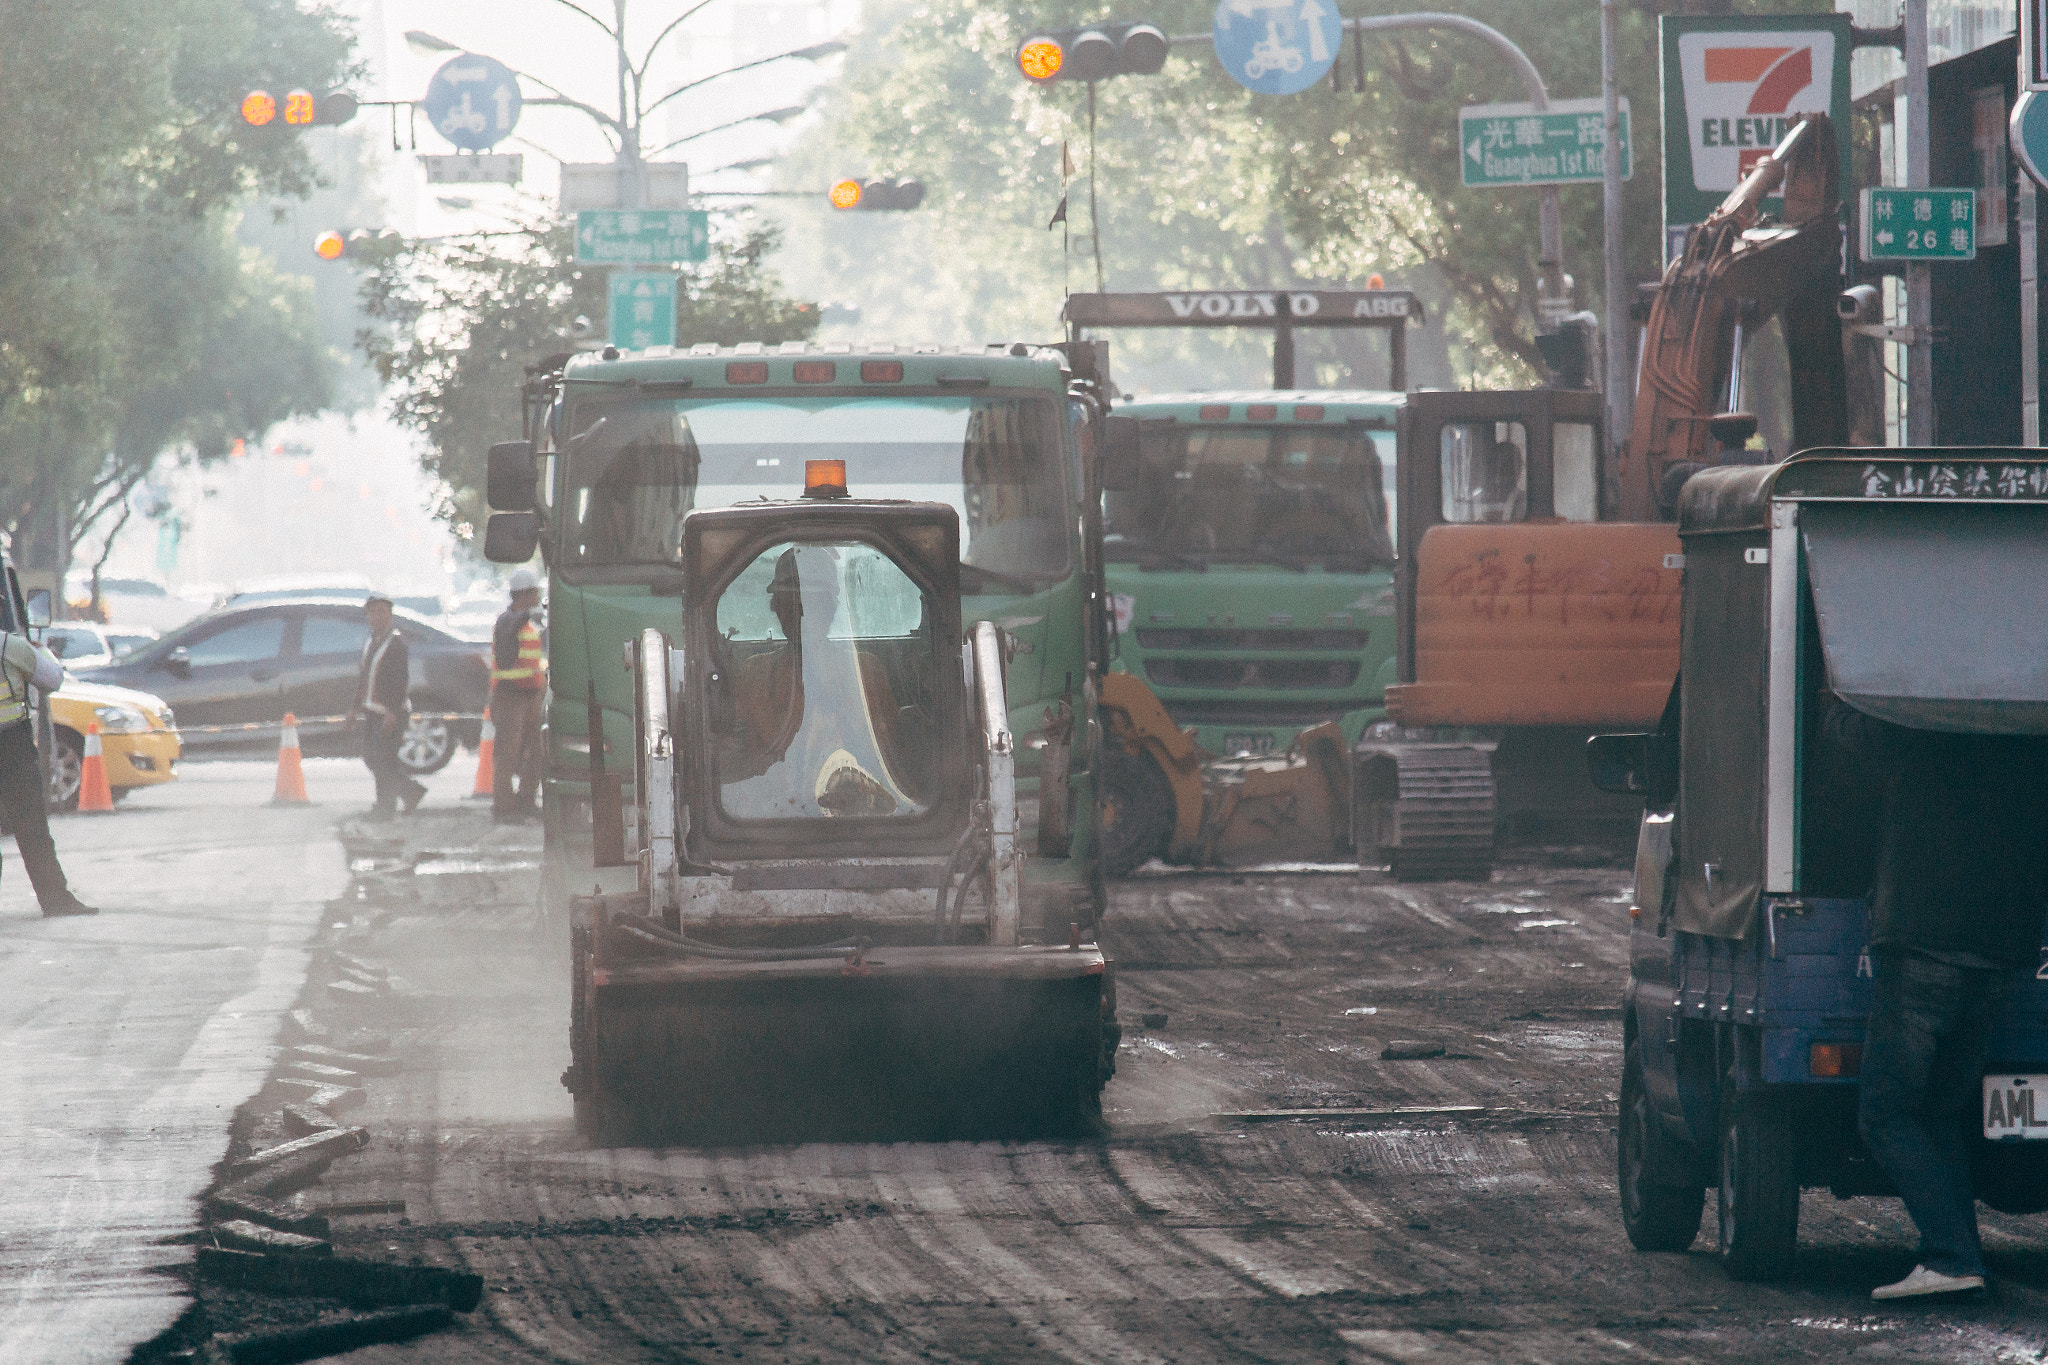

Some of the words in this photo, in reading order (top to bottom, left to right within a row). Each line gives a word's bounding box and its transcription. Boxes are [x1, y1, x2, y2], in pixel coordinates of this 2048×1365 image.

[1875, 198, 1970, 222] 林德街
[1353, 299, 1409, 317] ABG
